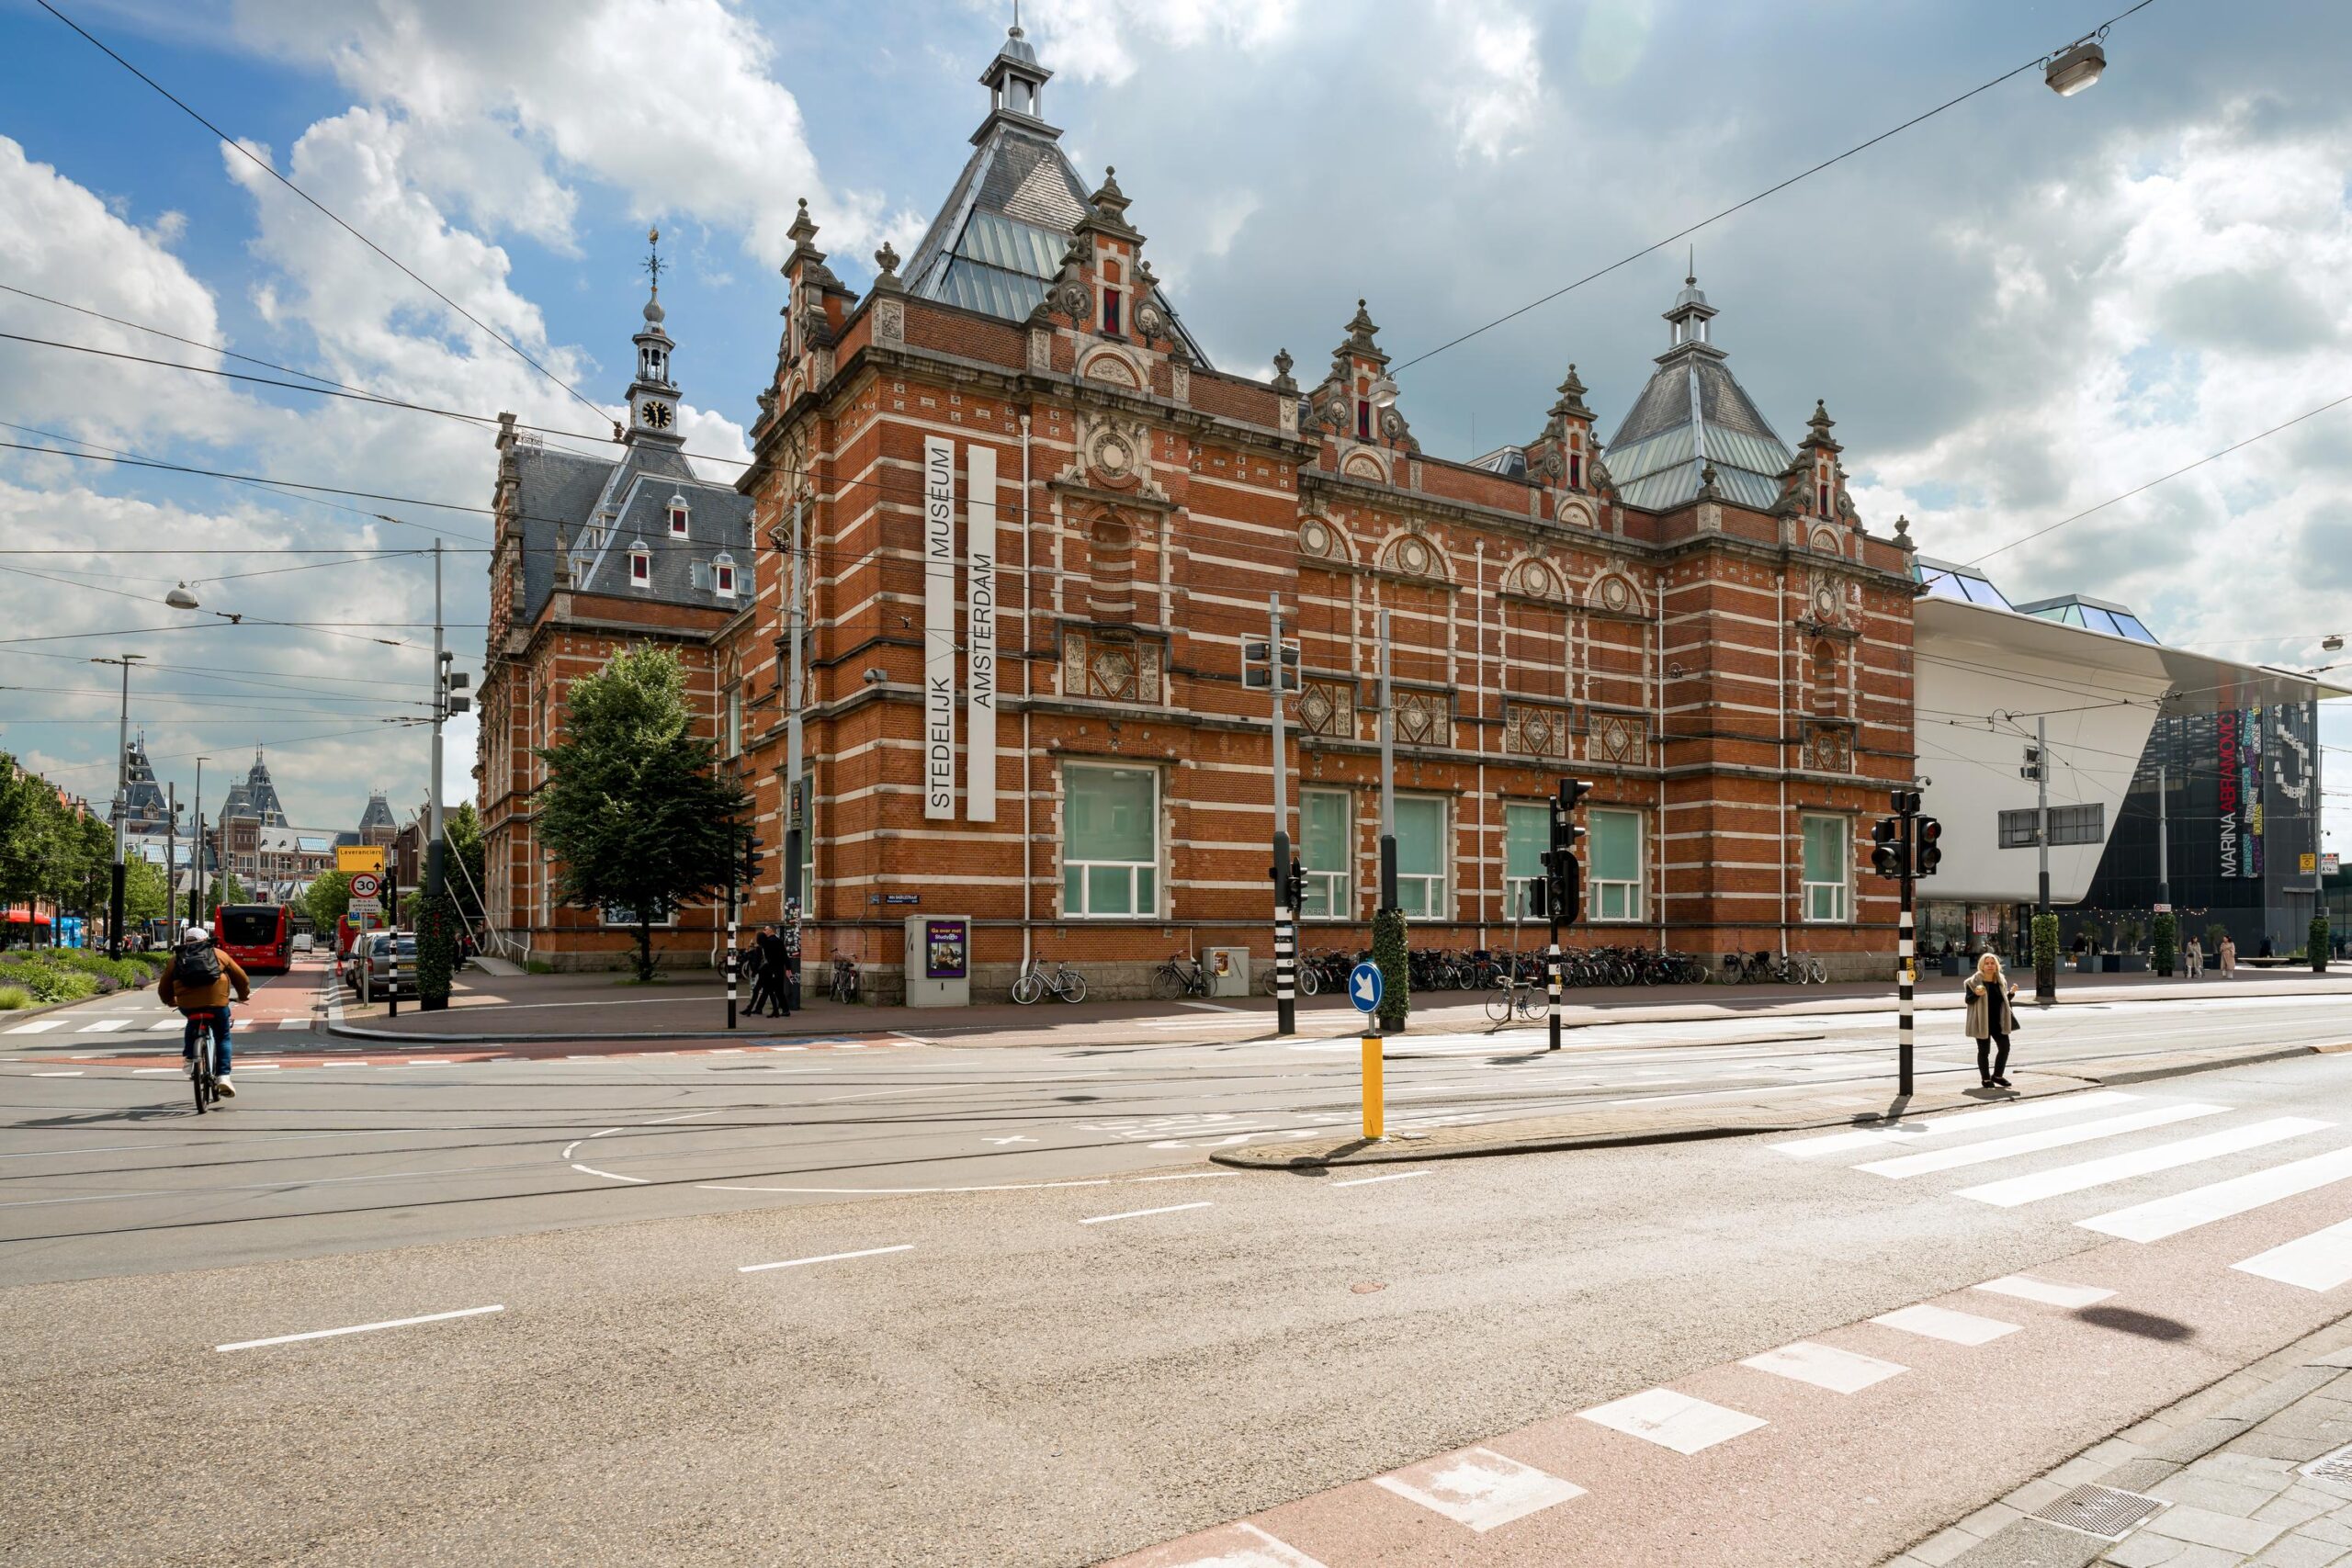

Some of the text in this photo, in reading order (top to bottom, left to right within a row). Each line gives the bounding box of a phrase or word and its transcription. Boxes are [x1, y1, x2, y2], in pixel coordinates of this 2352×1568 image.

[931, 447, 950, 808] STEDELIJK MUSEUM
[973, 553, 991, 709] AMSTERDAM
[2221, 812, 2236, 877] MARINA
[2254, 805, 2262, 834] DUMAS
[356, 880, 375, 891] 30
